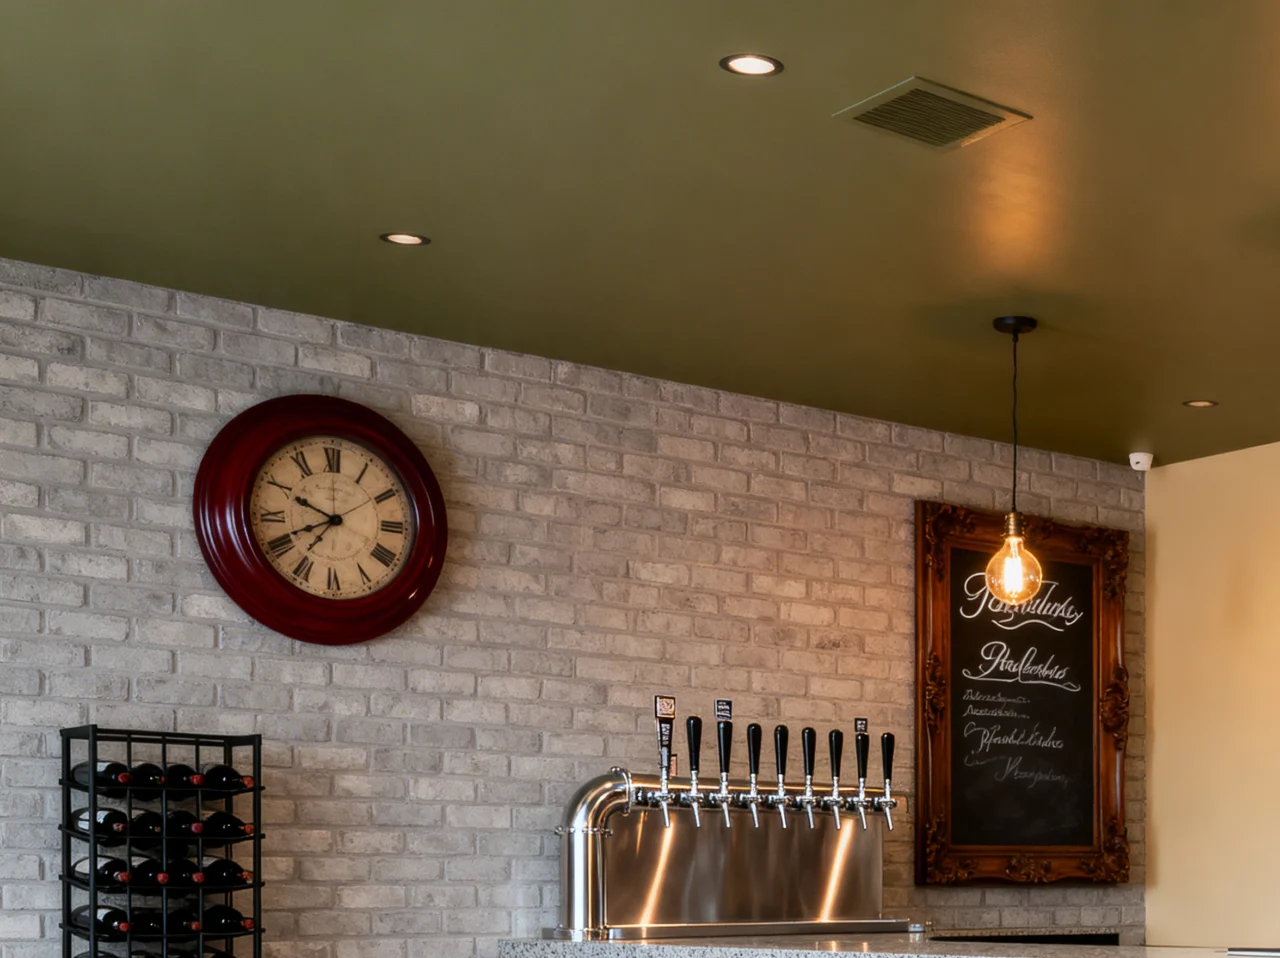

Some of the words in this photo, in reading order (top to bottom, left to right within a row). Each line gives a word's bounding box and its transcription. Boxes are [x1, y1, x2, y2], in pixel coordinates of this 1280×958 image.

[355, 462, 369, 485] I
[267, 474, 293, 500] X
[374, 488, 397, 505] II
[380, 520, 404, 535] III
[267, 532, 296, 560] VIII
[370, 542, 397, 569] IIII
[292, 555, 315, 583] VII
[326, 567, 341, 592] VI
[356, 561, 372, 586] V
